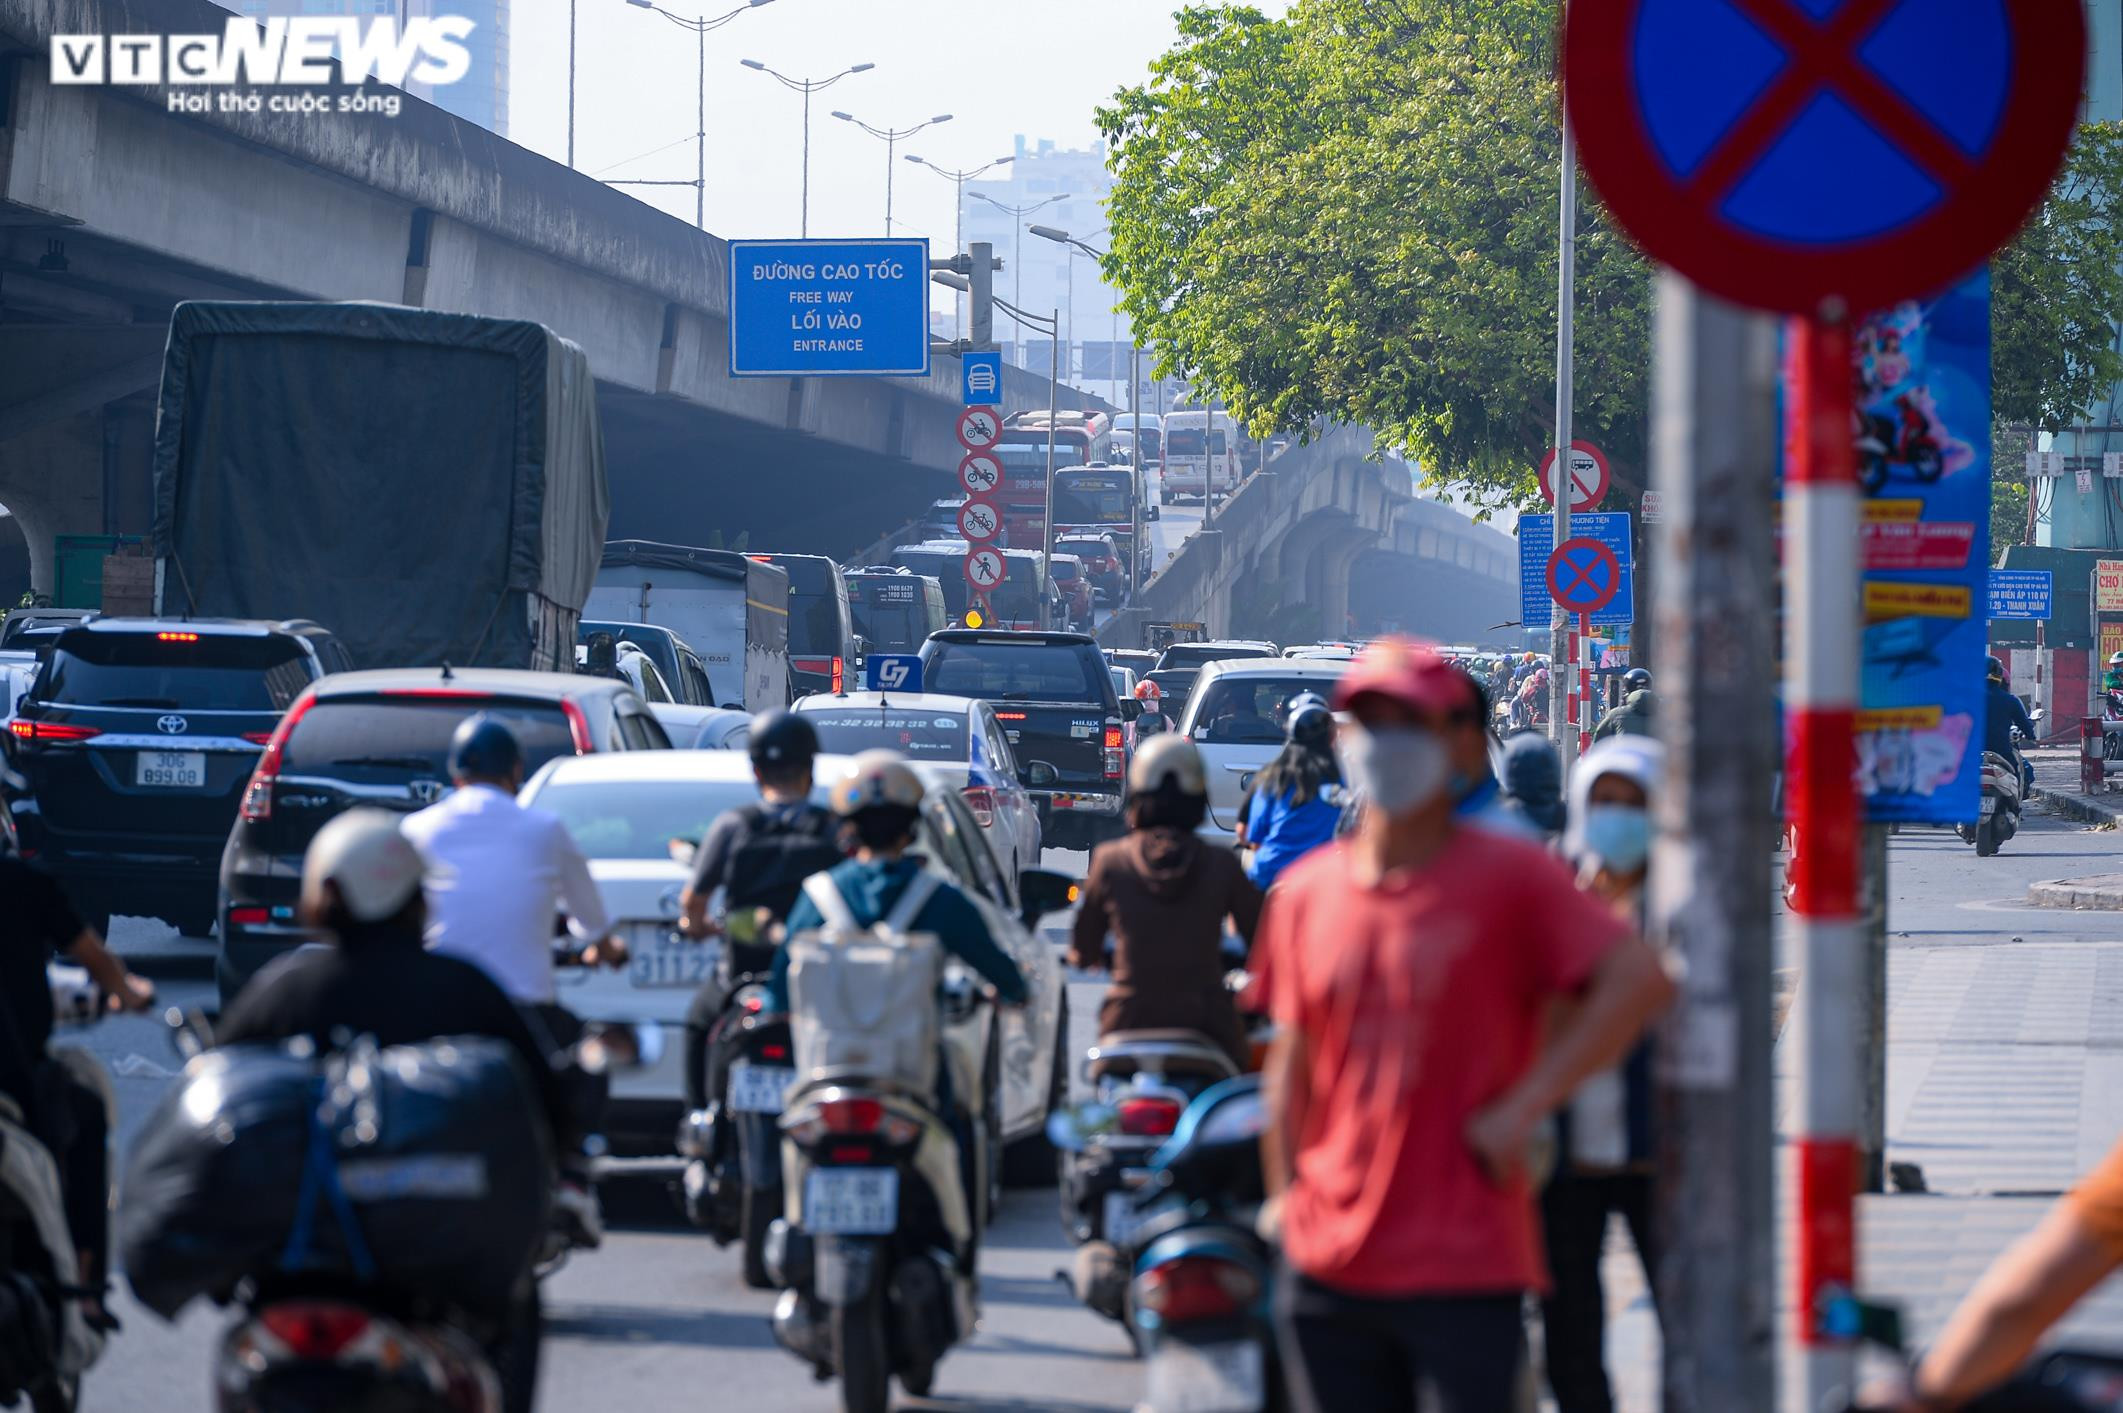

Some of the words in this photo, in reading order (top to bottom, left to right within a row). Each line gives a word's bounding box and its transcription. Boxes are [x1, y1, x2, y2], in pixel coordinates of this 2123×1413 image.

[752, 259, 816, 281] ĐƯỜNG
[821, 263, 860, 280] CAO
[864, 258, 904, 280] TỐC
[789, 291, 822, 304] FREE
[827, 291, 854, 304] WAY
[791, 308, 821, 330] LỐI
[827, 309, 862, 330] VÀO
[793, 339, 864, 352] ENTRANCE
[879, 658, 910, 688] G7
[840, 719, 860, 727] 32
[863, 720, 882, 728] 32
[884, 720, 906, 728] 32
[1072, 719, 1099, 727] HILUX
[156, 753, 186, 768] 30G
